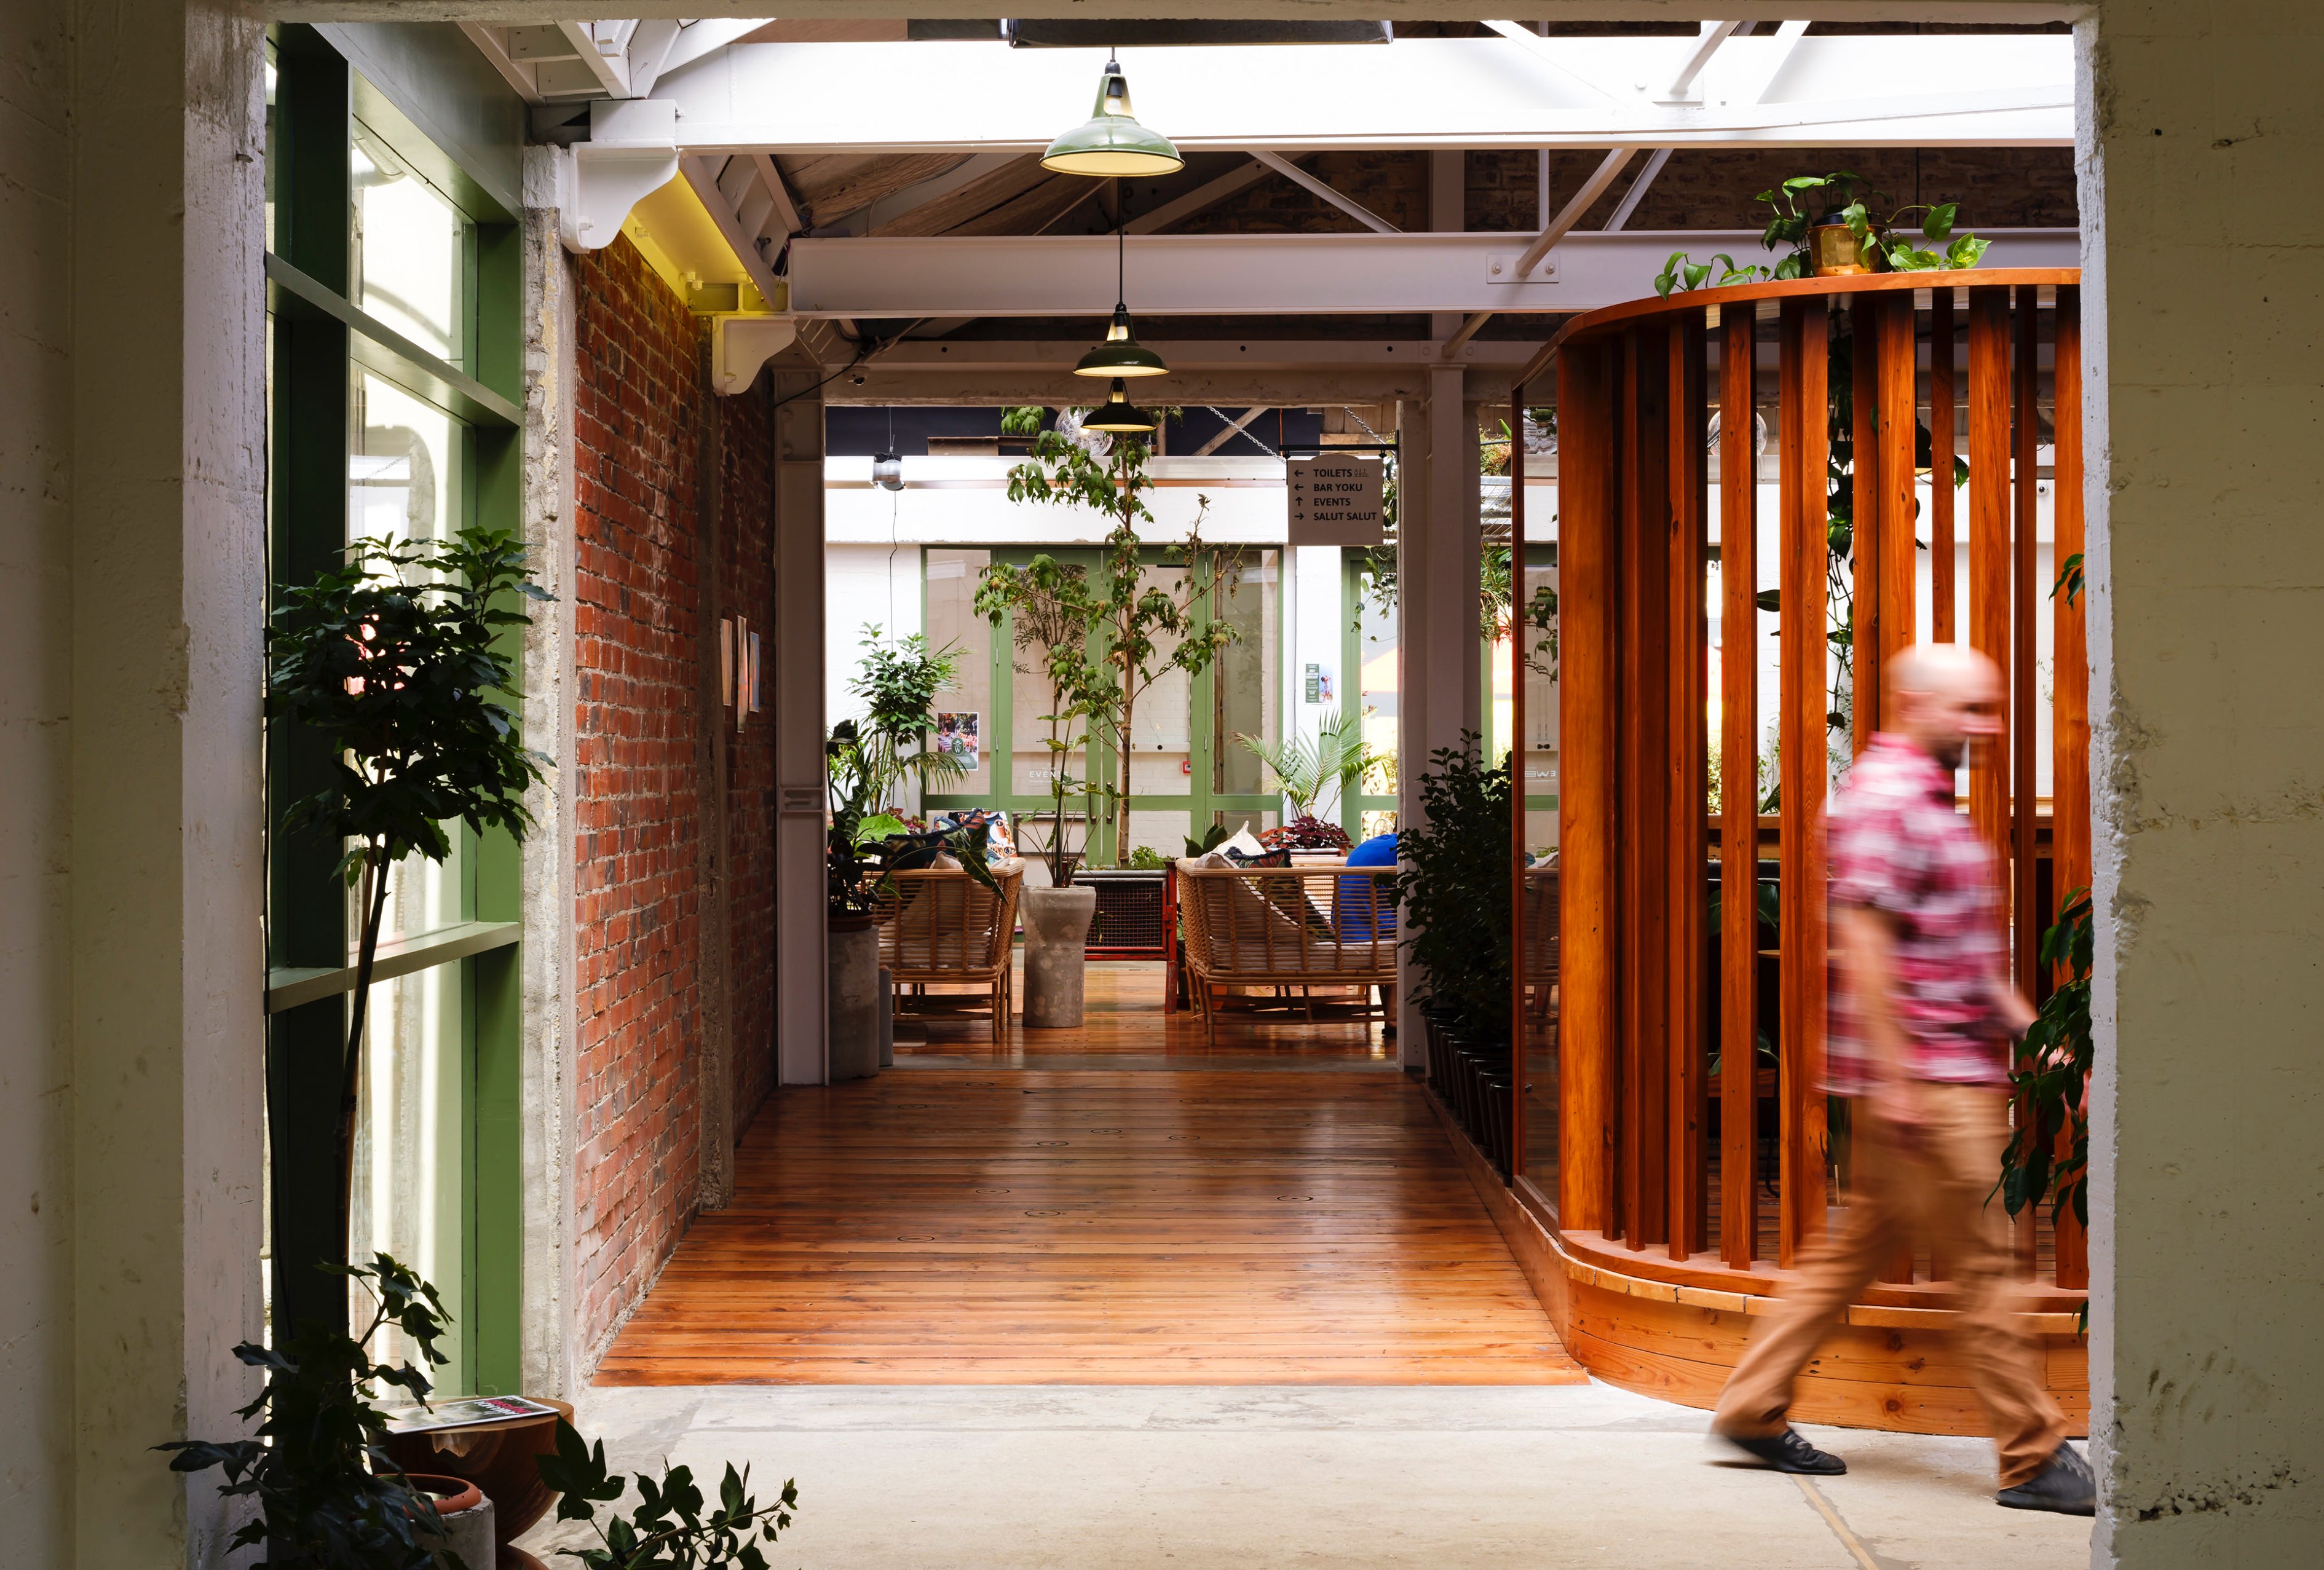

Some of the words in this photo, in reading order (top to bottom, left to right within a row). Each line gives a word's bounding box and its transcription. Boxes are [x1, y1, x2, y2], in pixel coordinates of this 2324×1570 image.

[1313, 468, 1352, 478] TOILETS
[1313, 483, 1332, 492] BAR
[1335, 483, 1362, 492] YOKU
[1313, 498, 1351, 507] EVENTS
[1313, 512, 1344, 521] SALUT
[1346, 512, 1377, 521] SALUT
